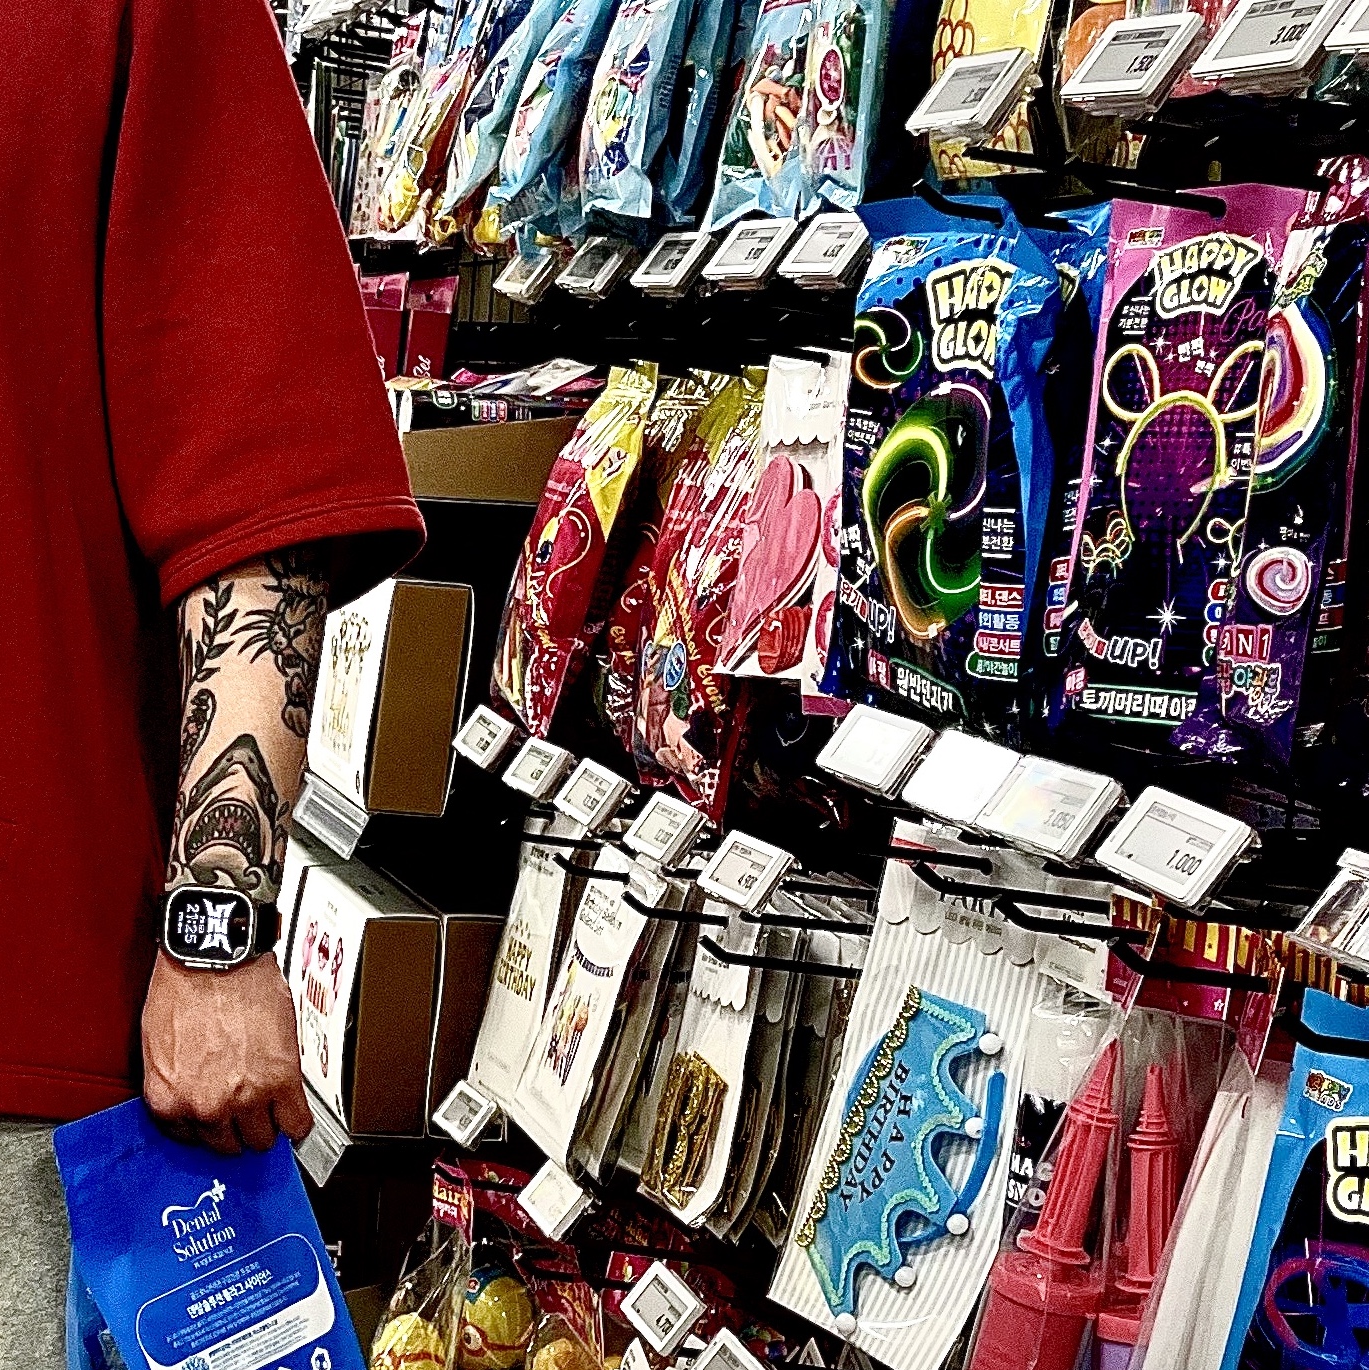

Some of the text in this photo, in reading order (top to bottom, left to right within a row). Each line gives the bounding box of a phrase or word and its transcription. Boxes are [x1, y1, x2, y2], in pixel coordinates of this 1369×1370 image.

[1159, 241, 1260, 278] HAPPY
[934, 264, 1012, 320] HAP
[1162, 275, 1232, 310] GLOW
[981, 535, 1015, 551] 분전환
[979, 588, 1023, 607] 티,댄스
[979, 611, 1021, 630] 외활동
[979, 636, 1021, 653] 내콘서트
[1108, 635, 1163, 670] UP!
[184, 903, 200, 944] 21:25
[171, 1200, 222, 1239] Dental
[172, 1225, 236, 1262] Solution
